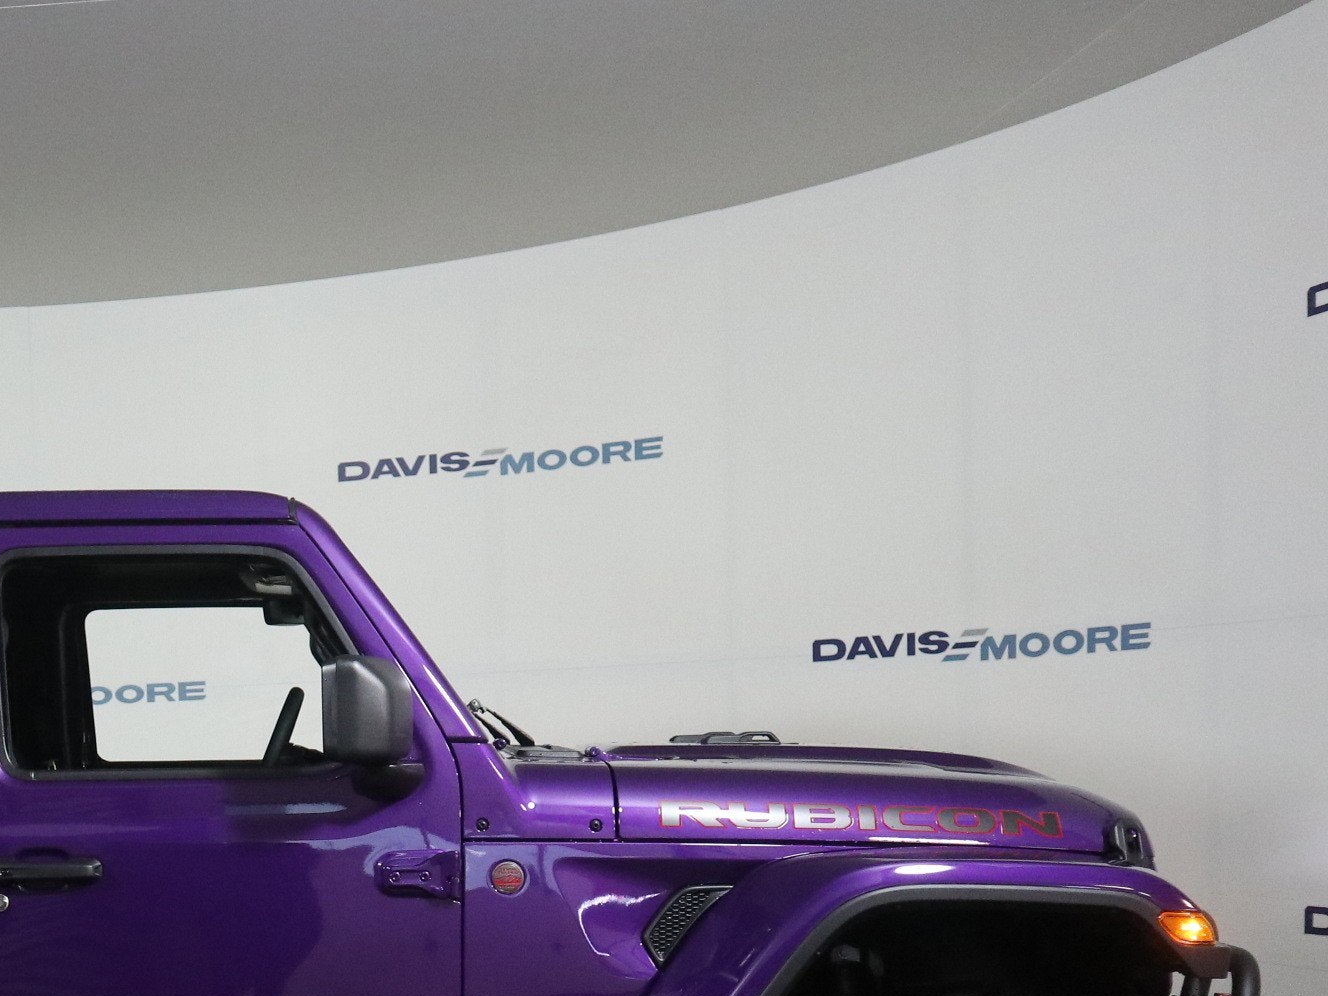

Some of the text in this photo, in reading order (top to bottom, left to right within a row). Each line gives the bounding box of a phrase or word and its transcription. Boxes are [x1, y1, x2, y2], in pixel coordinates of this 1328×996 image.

[338, 436, 663, 482] DAVIS MOORE
[812, 622, 1151, 662] DAVIS MOORE
[658, 800, 1063, 838] RUBICON
